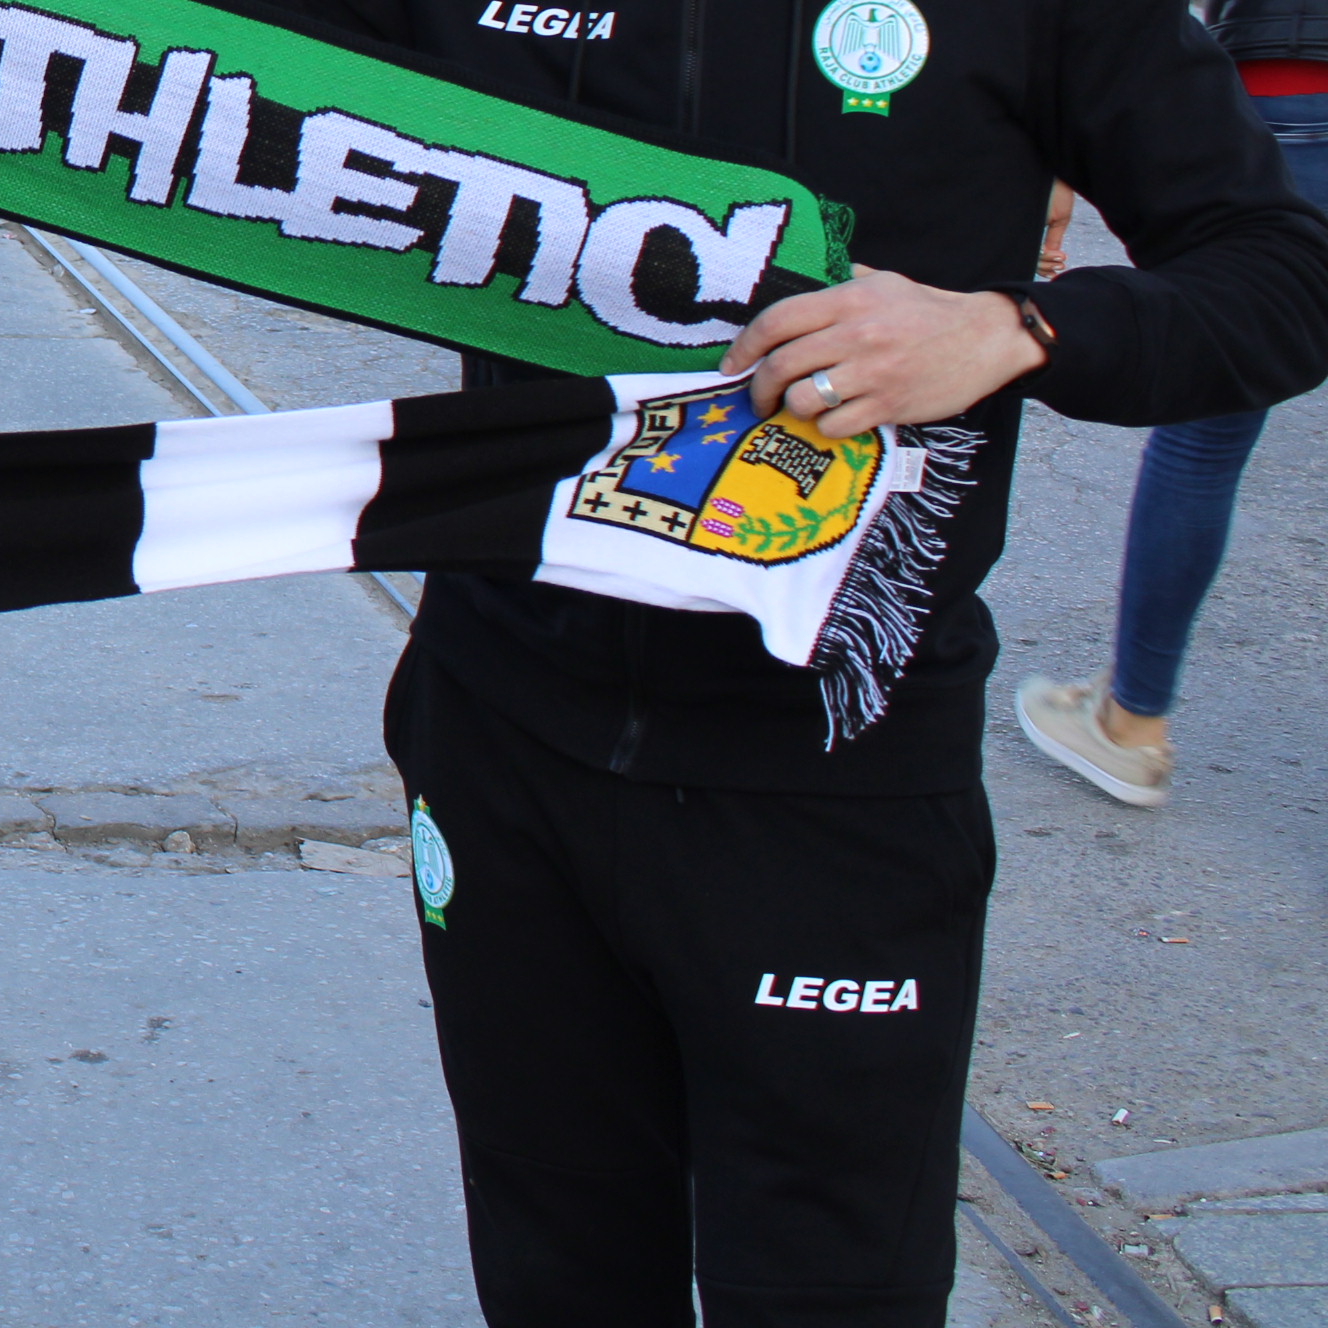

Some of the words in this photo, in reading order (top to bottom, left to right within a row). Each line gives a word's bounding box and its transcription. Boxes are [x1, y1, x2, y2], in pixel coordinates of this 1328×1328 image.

[819, 46, 839, 74] RAJA
[839, 73, 869, 90] CLUB
[874, 53, 922, 90] ATHLETIC
[754, 973, 920, 1013] LEGEA
